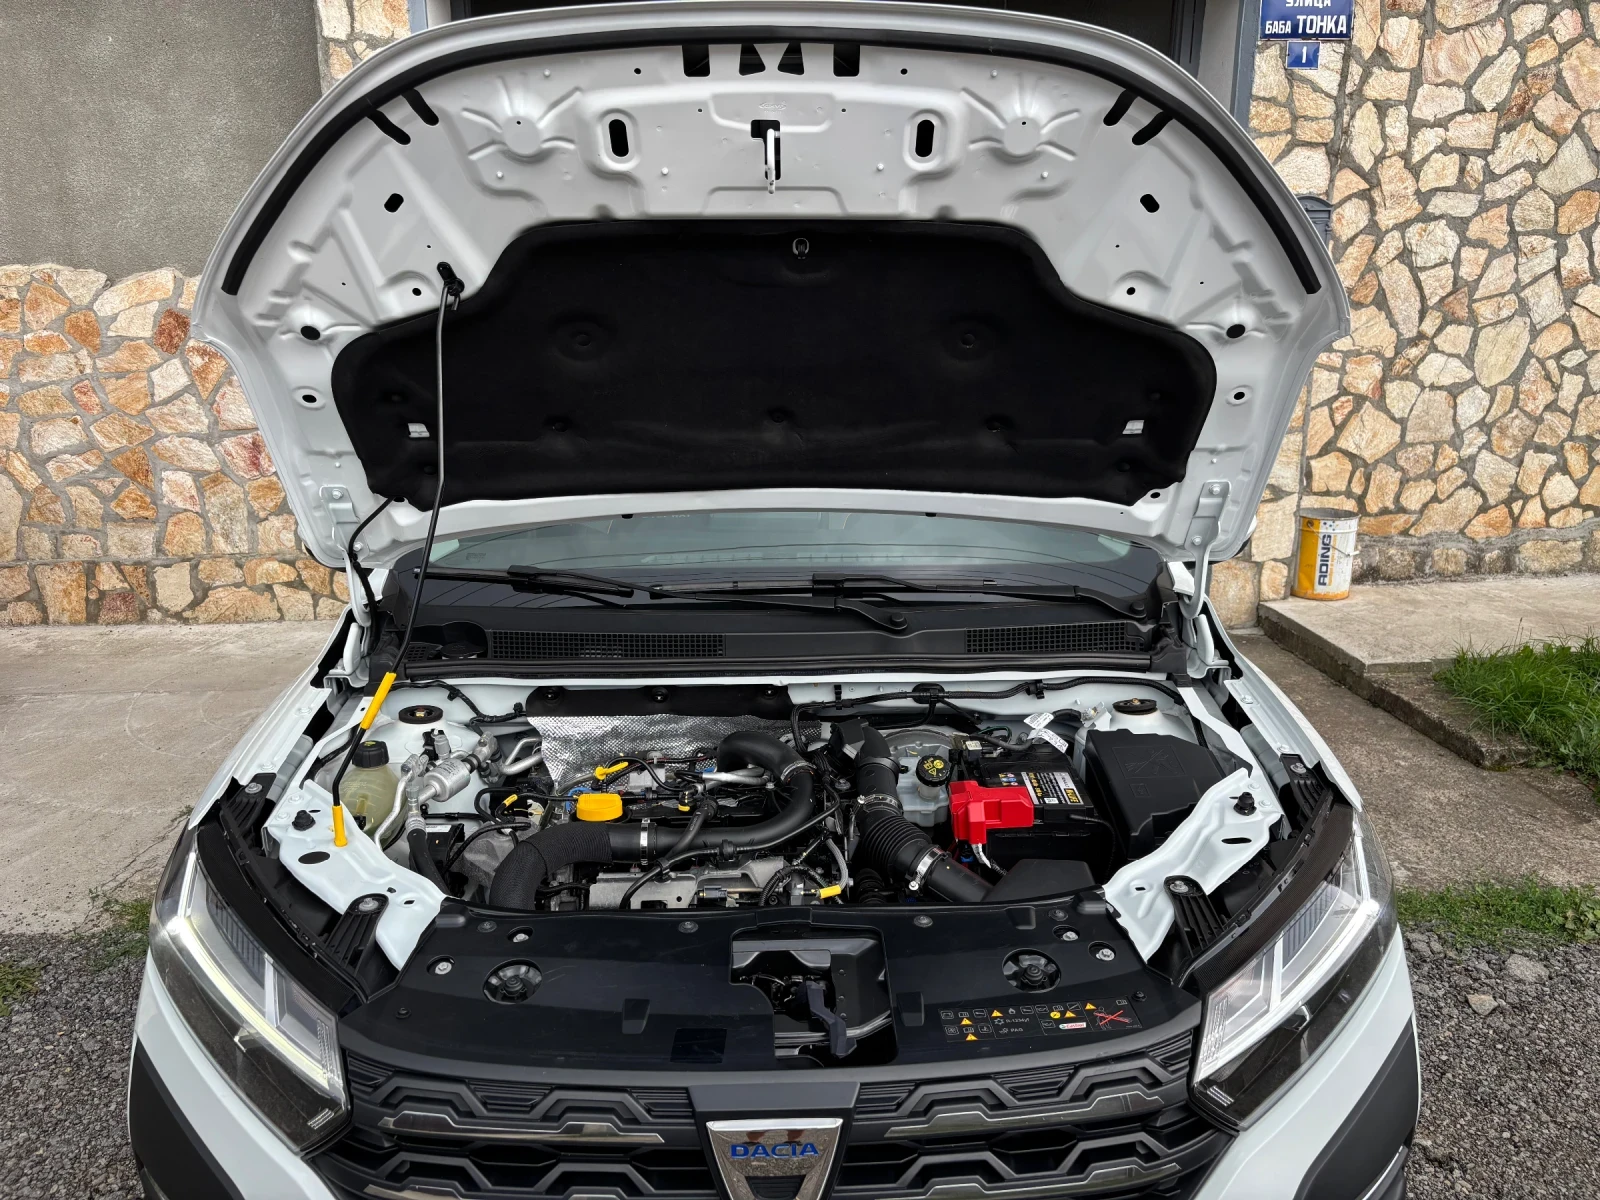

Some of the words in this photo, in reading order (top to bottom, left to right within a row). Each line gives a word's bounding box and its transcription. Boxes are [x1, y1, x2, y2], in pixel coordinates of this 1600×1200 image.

[1265, 20, 1292, 34] БАБА
[1296, 15, 1347, 34] ТОНКА
[1301, 46, 1307, 63] 1
[1318, 534, 1332, 586] ADING
[730, 1143, 819, 1159] DACIA
